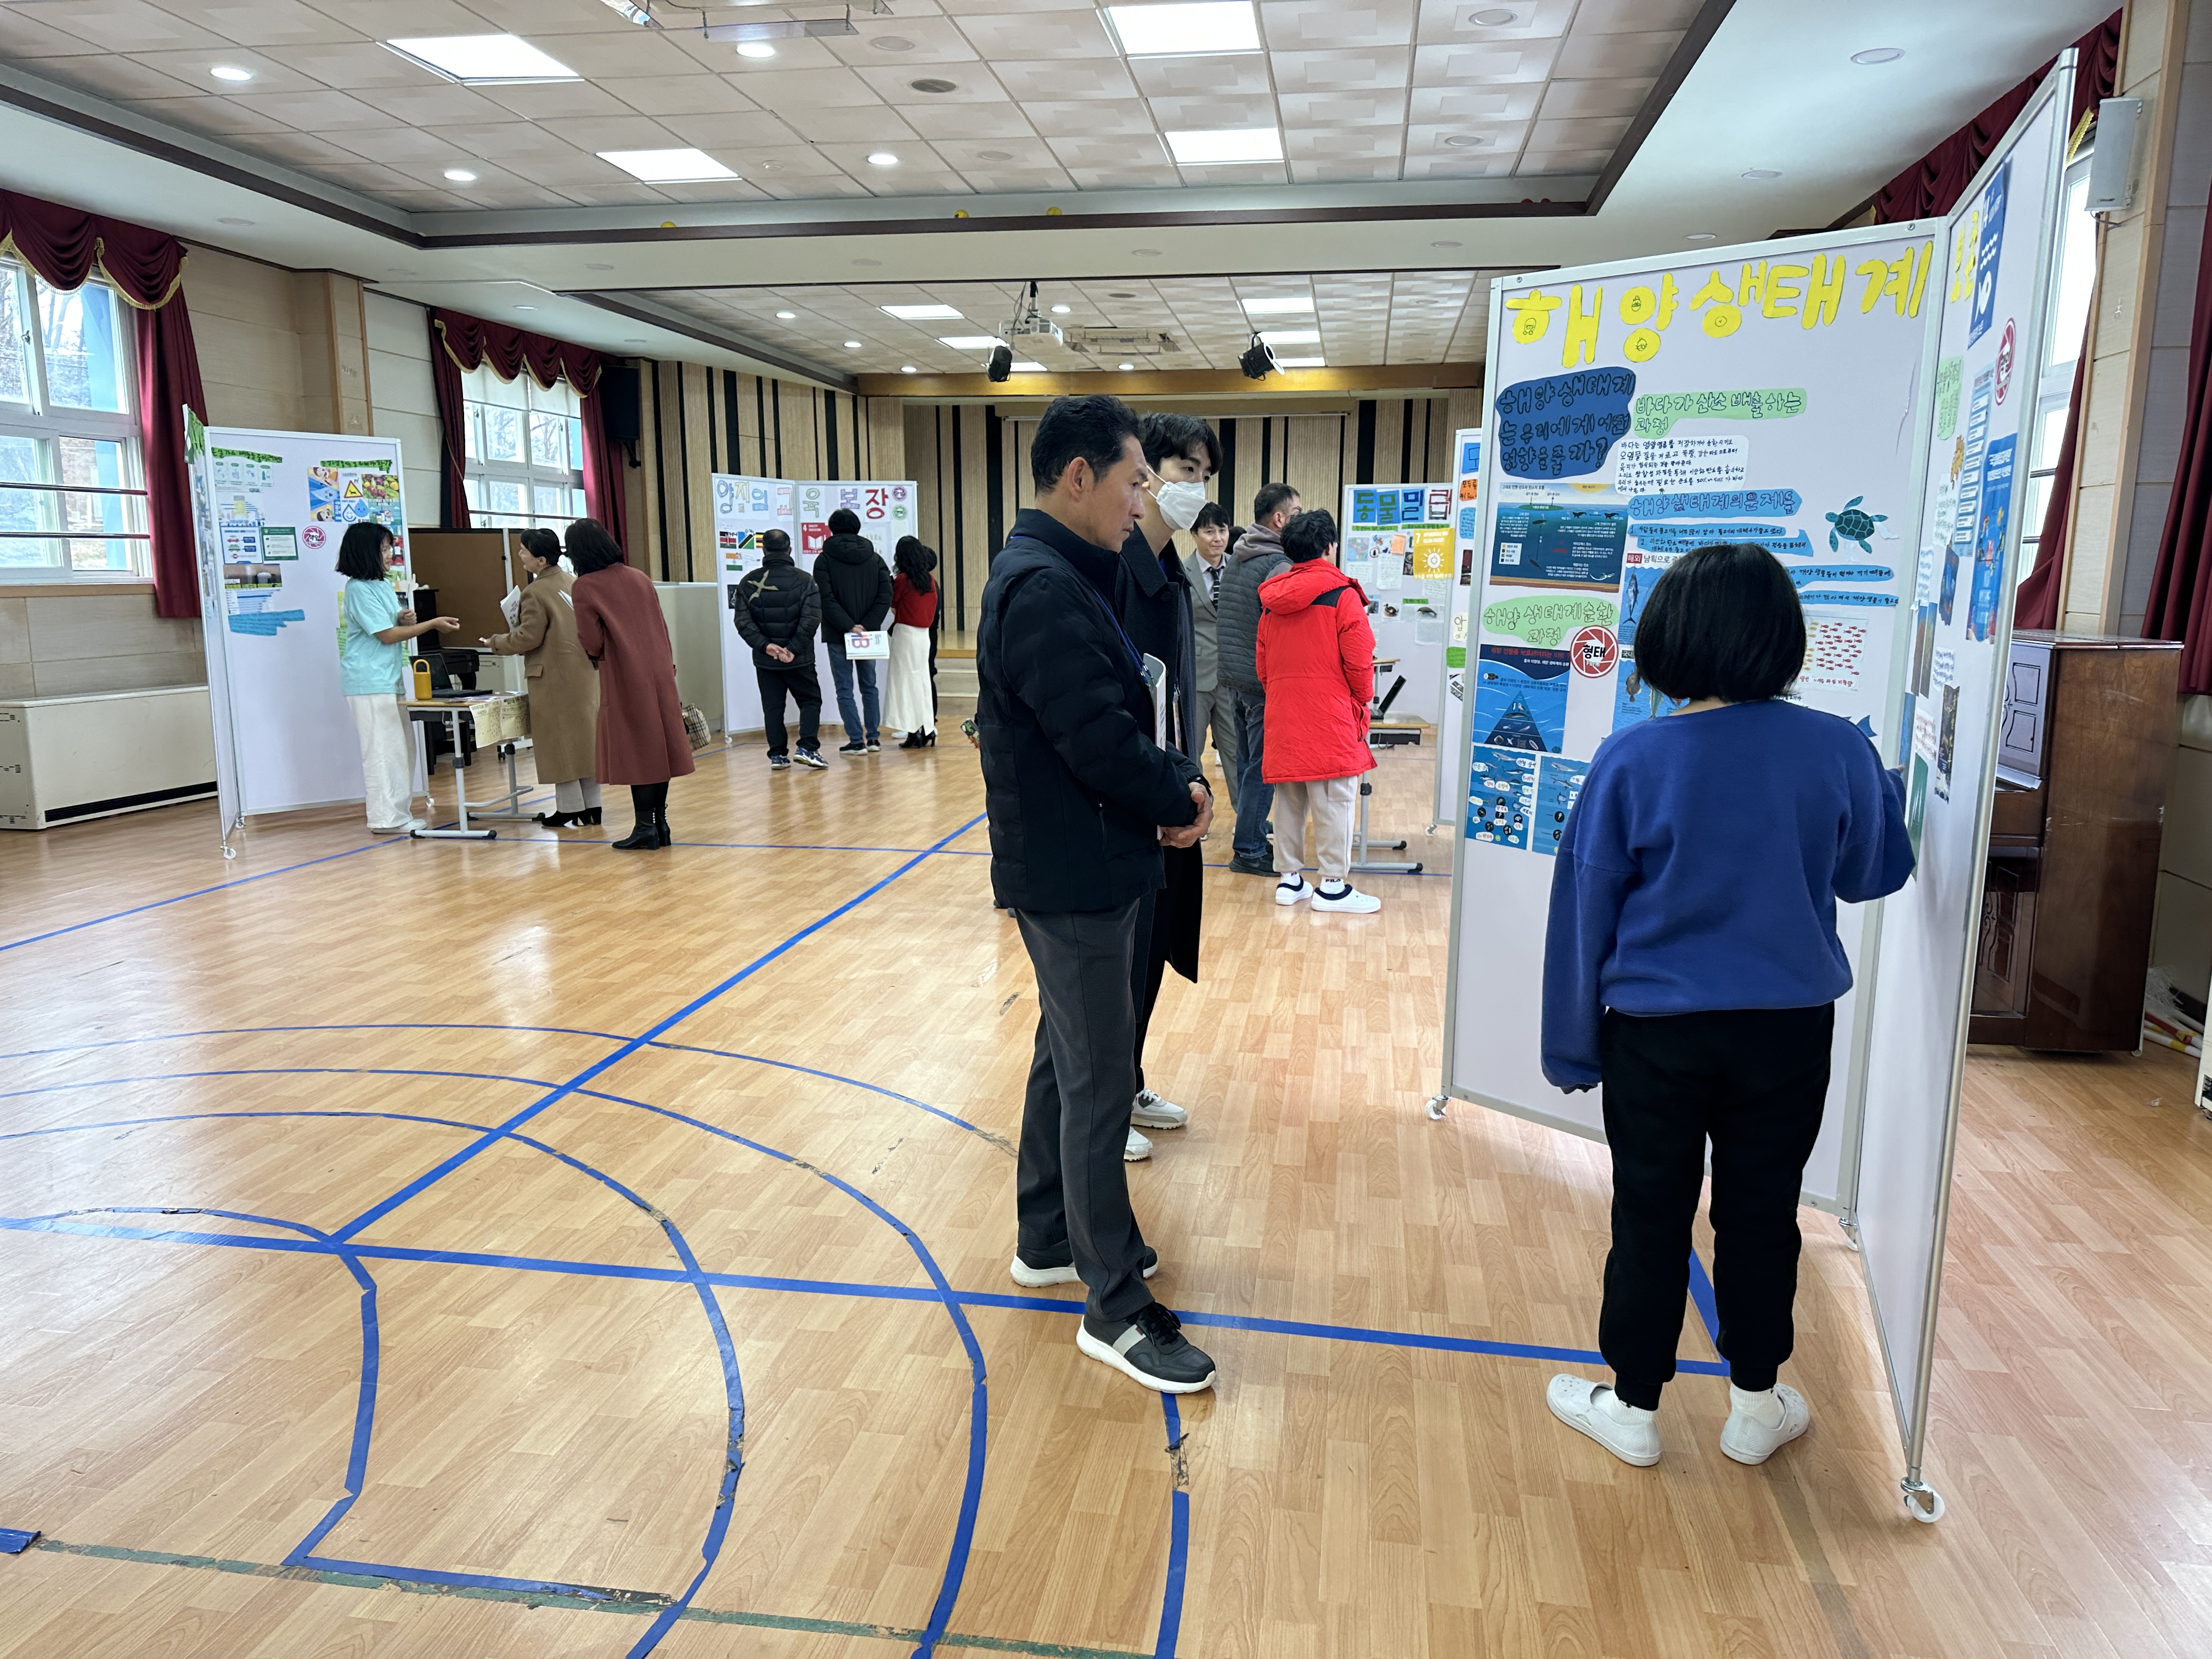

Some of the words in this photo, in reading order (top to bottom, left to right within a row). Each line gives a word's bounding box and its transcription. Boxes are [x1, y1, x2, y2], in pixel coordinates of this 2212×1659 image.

[1505, 273, 1678, 369] 해양
[1689, 241, 1933, 338] 생태계
[1499, 380, 1555, 414] 해양
[1558, 373, 1637, 407] 생태계
[1636, 394, 1694, 416] 바다가
[1697, 392, 1726, 413] 산소
[1731, 391, 1802, 419] 배출하는
[1500, 420, 1517, 446] 는
[1520, 413, 1594, 444] 우리에게
[1635, 416, 1668, 435] 과정
[1621, 441, 1639, 449] 바다는
[1503, 446, 1548, 471] 영향을
[717, 479, 768, 514] 양질의
[777, 487, 820, 518] 교육
[840, 488, 889, 519] 보장
[1630, 495, 1669, 516] 해양
[1415, 533, 1421, 544] 7
[1628, 554, 1641, 563] 해외
[1644, 555, 1670, 563] 남획으로
[1484, 608, 1521, 630] 해양
[1527, 628, 1560, 646] 과정
[1583, 644, 1606, 658] 형태
